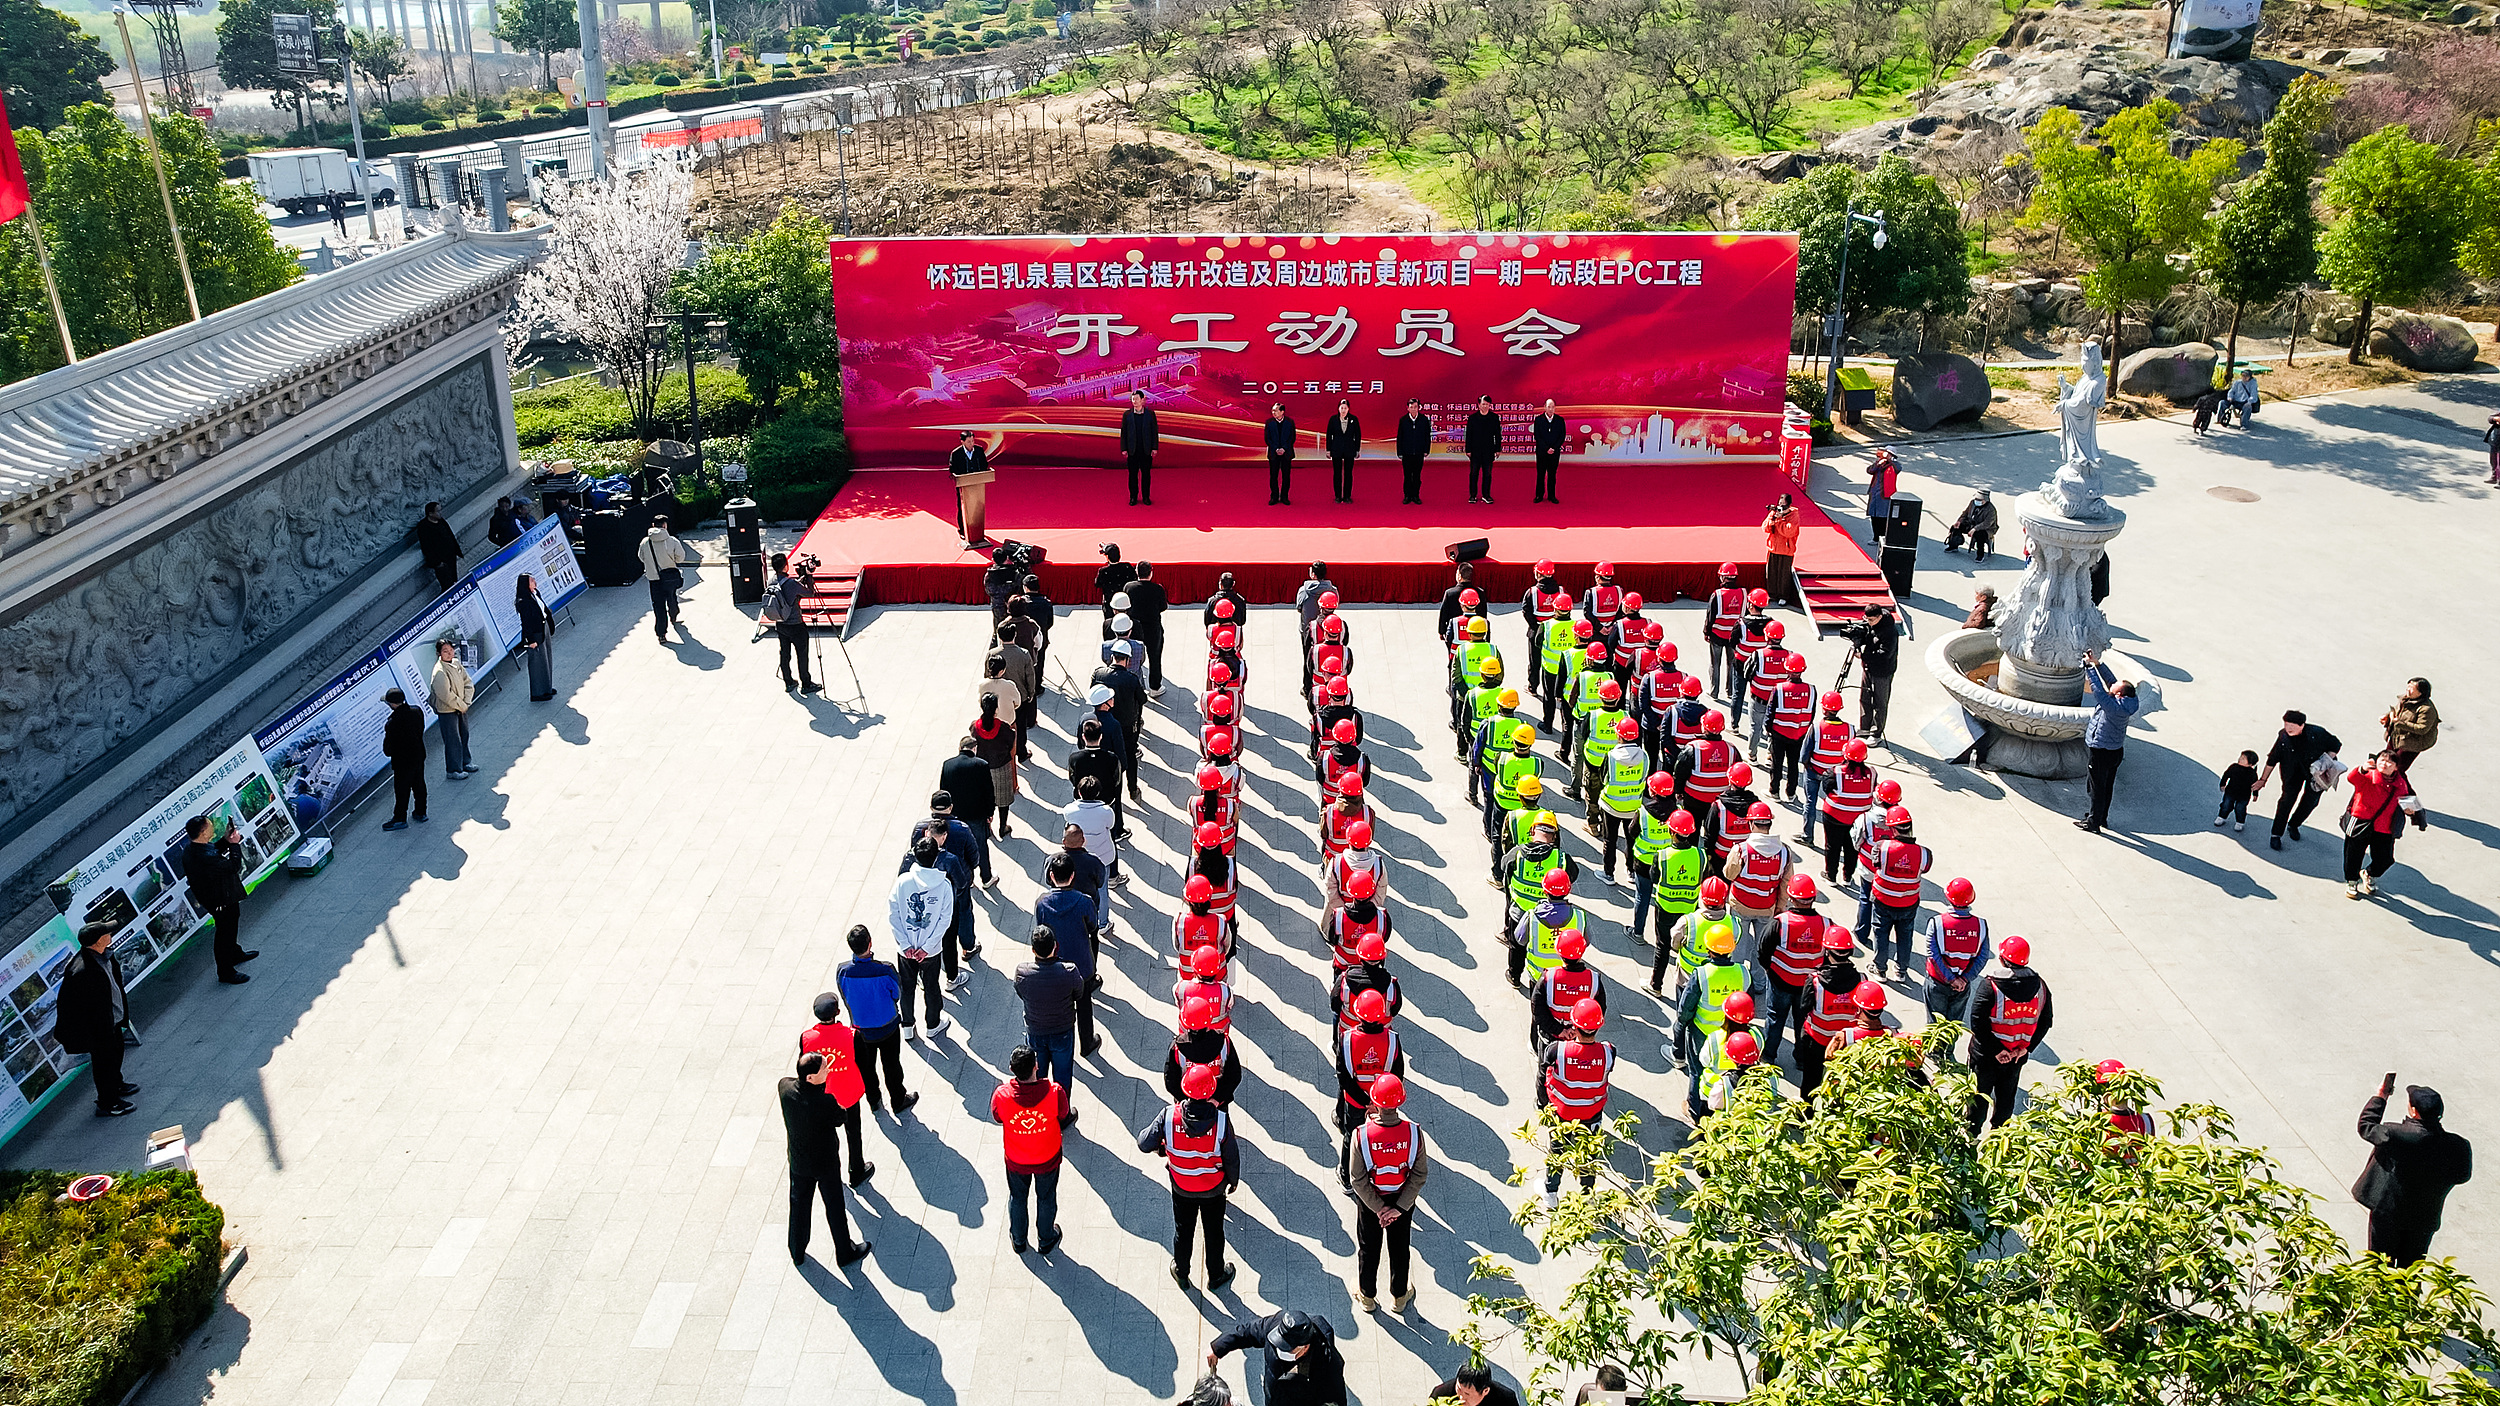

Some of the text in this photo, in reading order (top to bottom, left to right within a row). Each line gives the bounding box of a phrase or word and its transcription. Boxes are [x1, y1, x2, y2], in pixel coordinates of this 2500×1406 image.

[926, 259, 1703, 290] 怀远白乳泉景区综合提升改造及周边城市更新项目一期一标段EPC工程
[1046, 305, 1581, 357] 开工动员会
